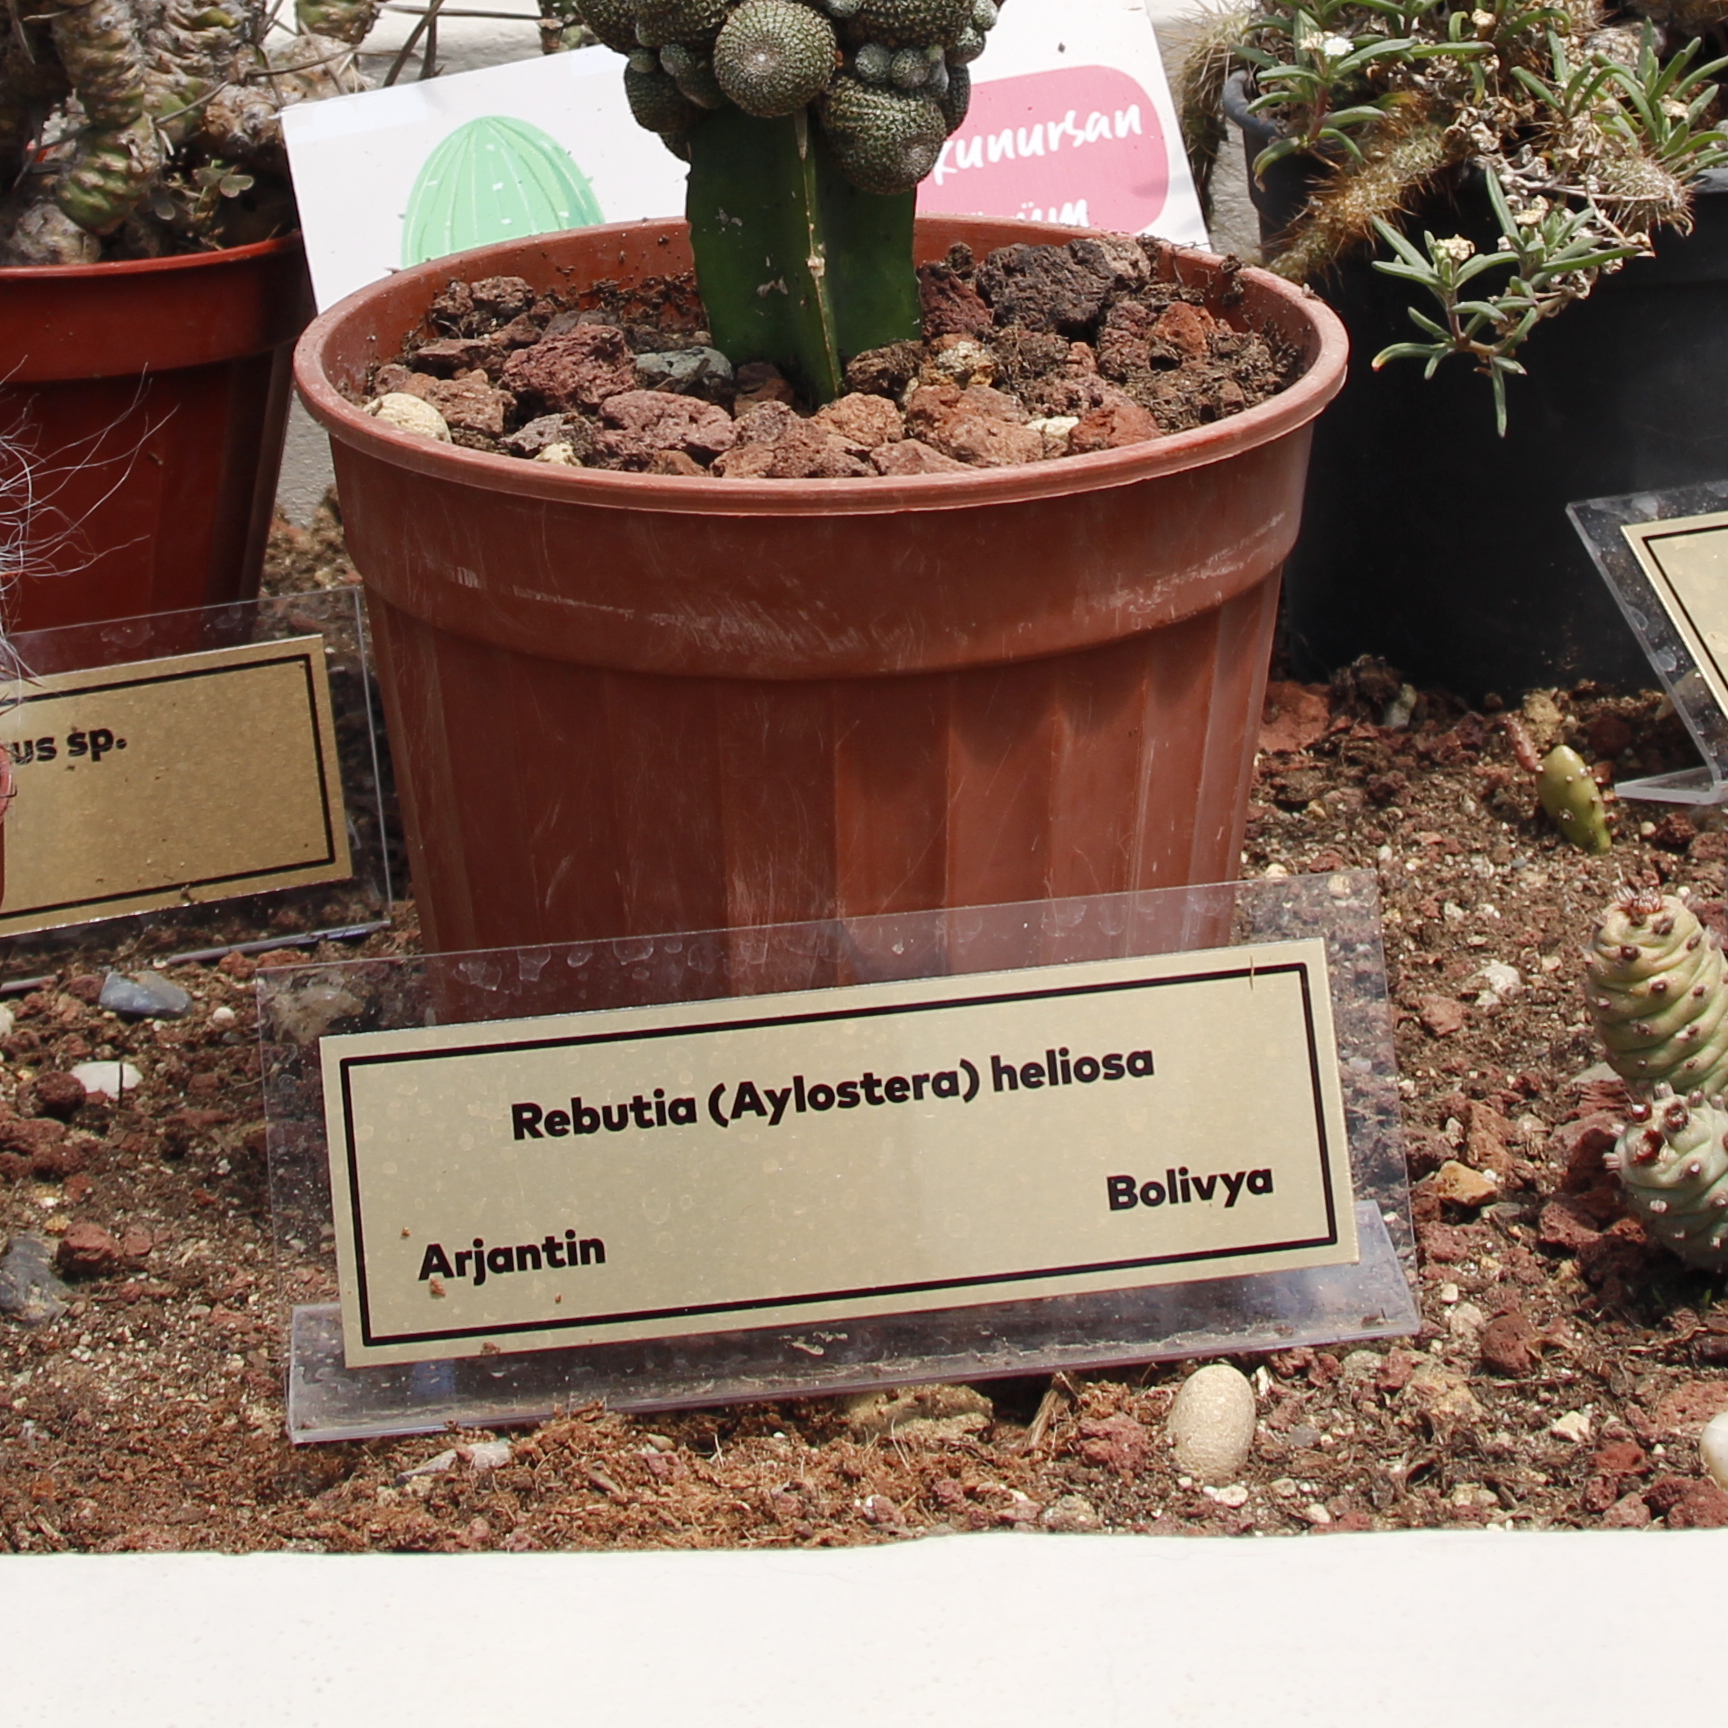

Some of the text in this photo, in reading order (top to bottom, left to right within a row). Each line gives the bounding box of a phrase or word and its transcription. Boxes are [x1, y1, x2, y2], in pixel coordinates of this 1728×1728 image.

[10, 728, 127, 765] us sp.
[511, 1047, 1154, 1141] Rebutia (Aylostera) heliosa
[1107, 1168, 1273, 1212] Bolivya
[418, 1229, 607, 1286] Arjantin
